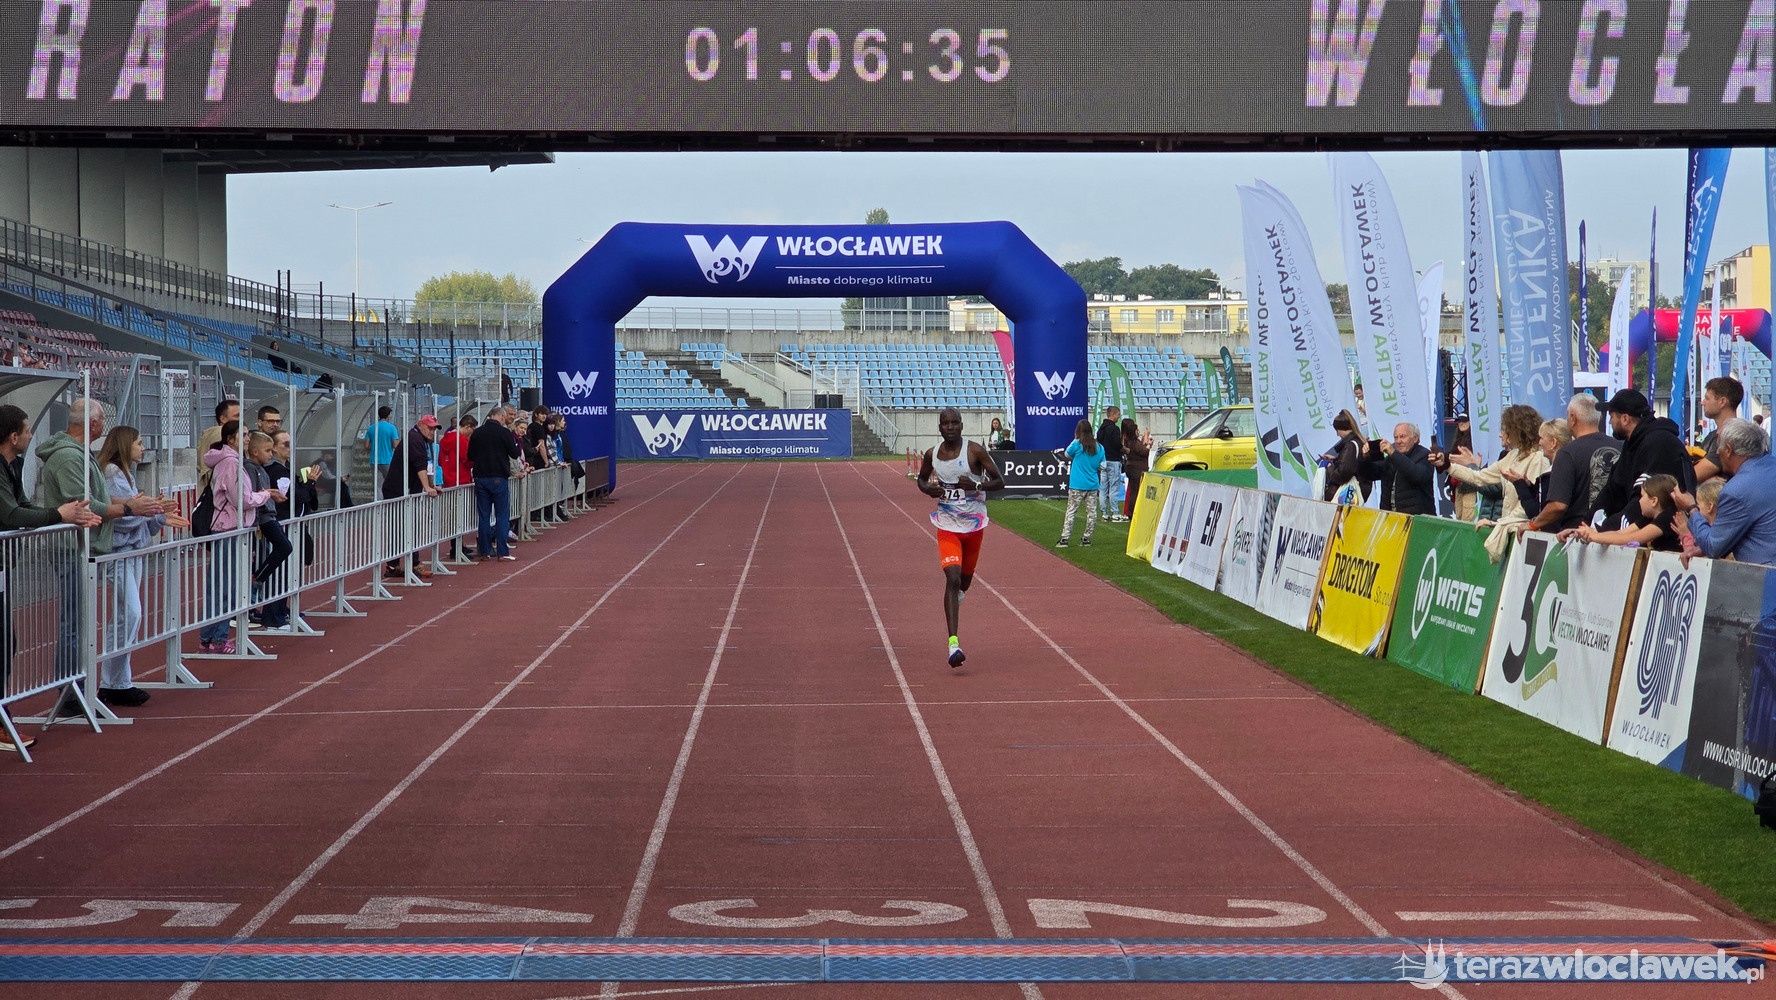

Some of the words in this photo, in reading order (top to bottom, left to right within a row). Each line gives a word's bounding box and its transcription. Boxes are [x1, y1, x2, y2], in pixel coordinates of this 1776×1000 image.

[684, 27, 1011, 82] 01:06:35
[776, 235, 943, 257] WŁOCŁAWEK
[787, 275, 830, 285] Miasto
[833, 275, 884, 287] dobrego
[887, 275, 933, 285] klimatu
[550, 405, 608, 416] WŁOCŁAWEK
[701, 413, 828, 432] WŁOCŁAWEK
[1026, 405, 1084, 416] WŁOCŁAWEK
[709, 446, 743, 456] Miasto
[744, 445, 783, 456] dobrego
[784, 445, 820, 455] klimatu
[1004, 460, 1072, 476] Portofi
[1436, 577, 1487, 618] WATIS
[1575, 626, 1612, 652] WŁOCŁAWEK
[1621, 719, 1671, 750] WŁOCŁAWEK
[1702, 739, 1776, 781] WWW.OSIR.WLOCLA
[289, 898, 595, 929] 4
[667, 898, 969, 930] 3
[1028, 898, 1328, 929] 2
[1395, 899, 1701, 923] 1
